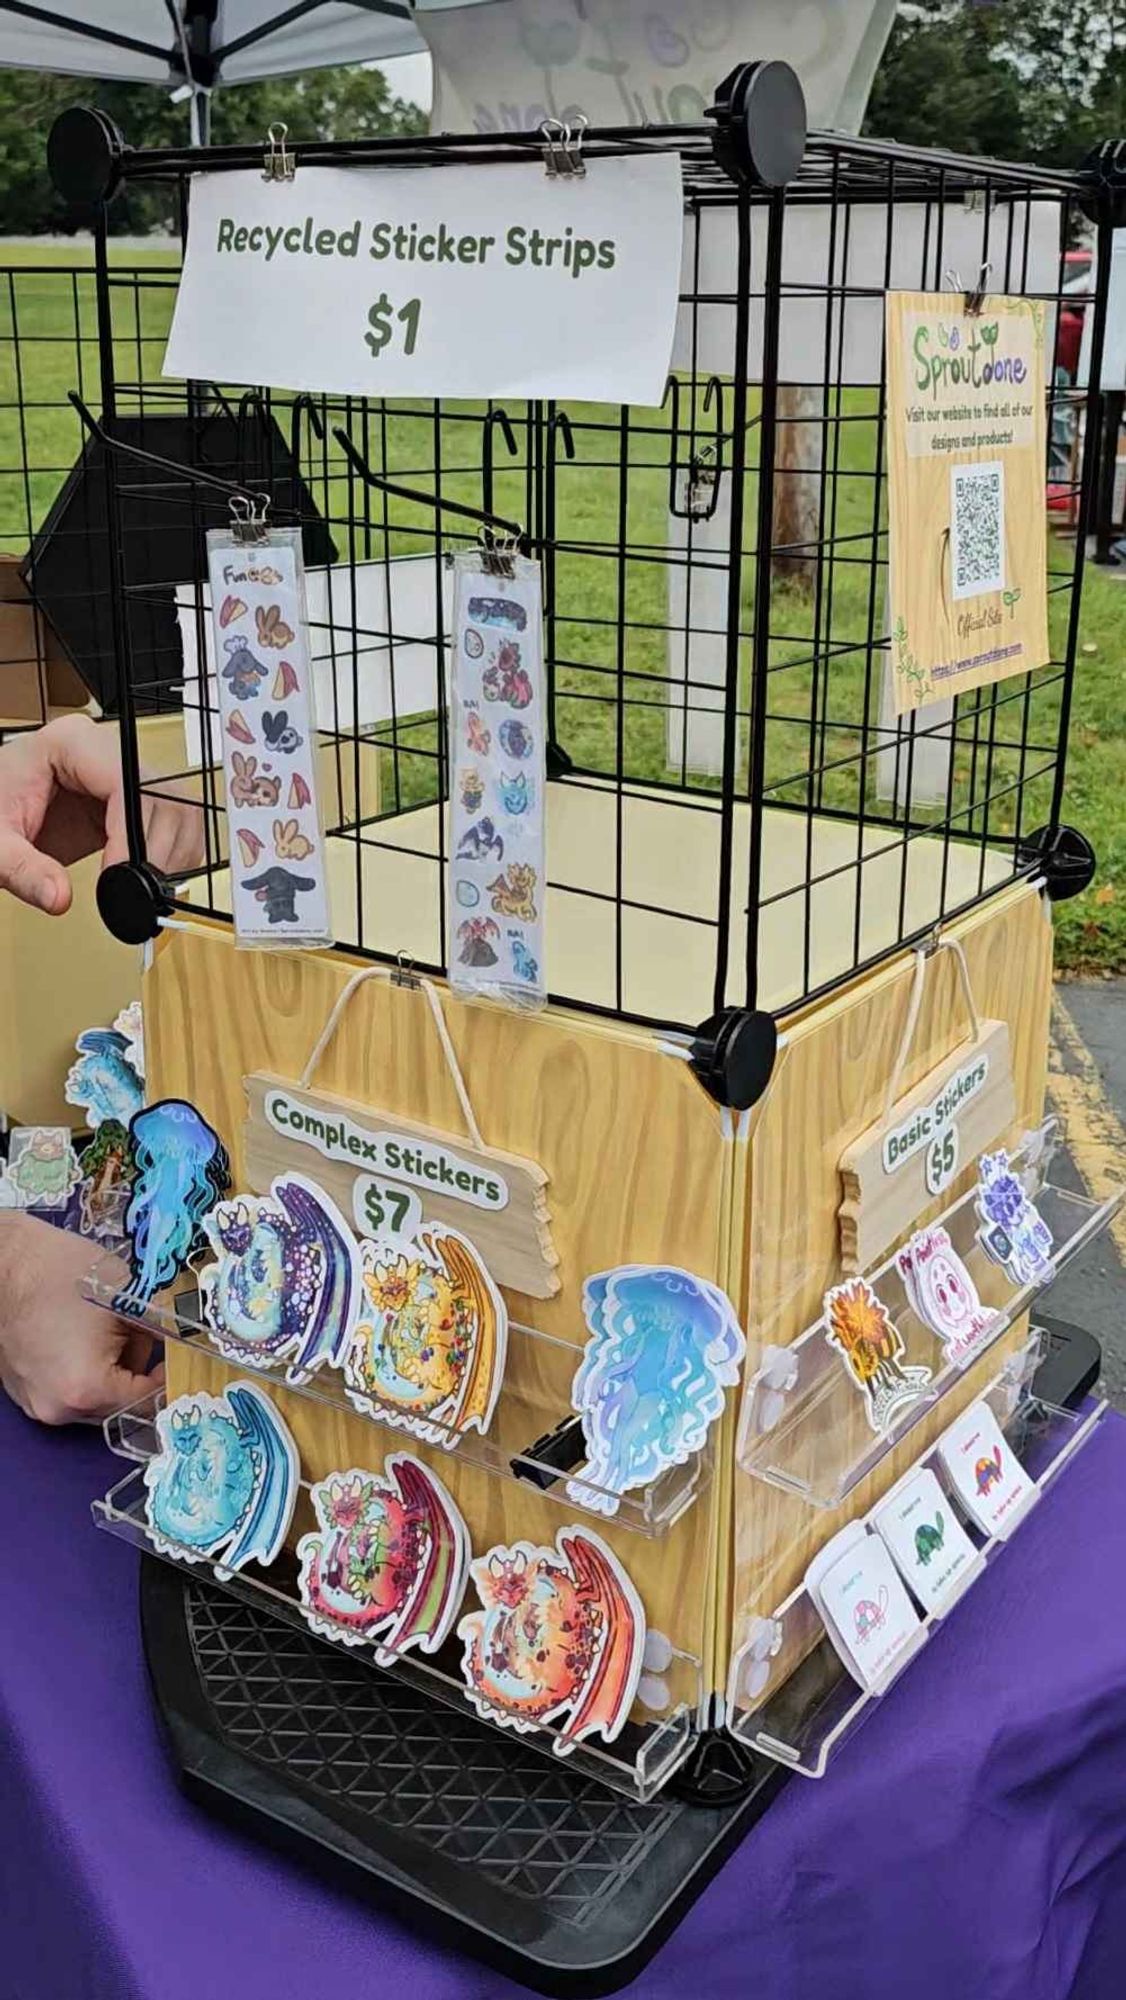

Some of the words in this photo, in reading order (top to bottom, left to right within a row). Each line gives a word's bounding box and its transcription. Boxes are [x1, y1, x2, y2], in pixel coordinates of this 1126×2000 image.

[217, 217, 361, 261] Recycled
[369, 223, 495, 264] Sticker
[505, 227, 616, 278] Strips
[364, 293, 421, 358] $1
[905, 406, 925, 423] Visit
[927, 409, 940, 422] our
[942, 405, 973, 421] website
[974, 406, 983, 419] to
[984, 402, 998, 418] find
[1000, 402, 1011, 418] all
[1012, 402, 1021, 418] of
[1021, 405, 1034, 417] our
[931, 433, 960, 453] designs
[962, 431, 976, 448] and
[888, 1115, 931, 1165] Basic
[935, 1062, 986, 1126] Stickers
[272, 1099, 377, 1163] Complex
[385, 1142, 500, 1202] Stickers
[931, 1130, 955, 1186] $5
[365, 1183, 411, 1233] $7
